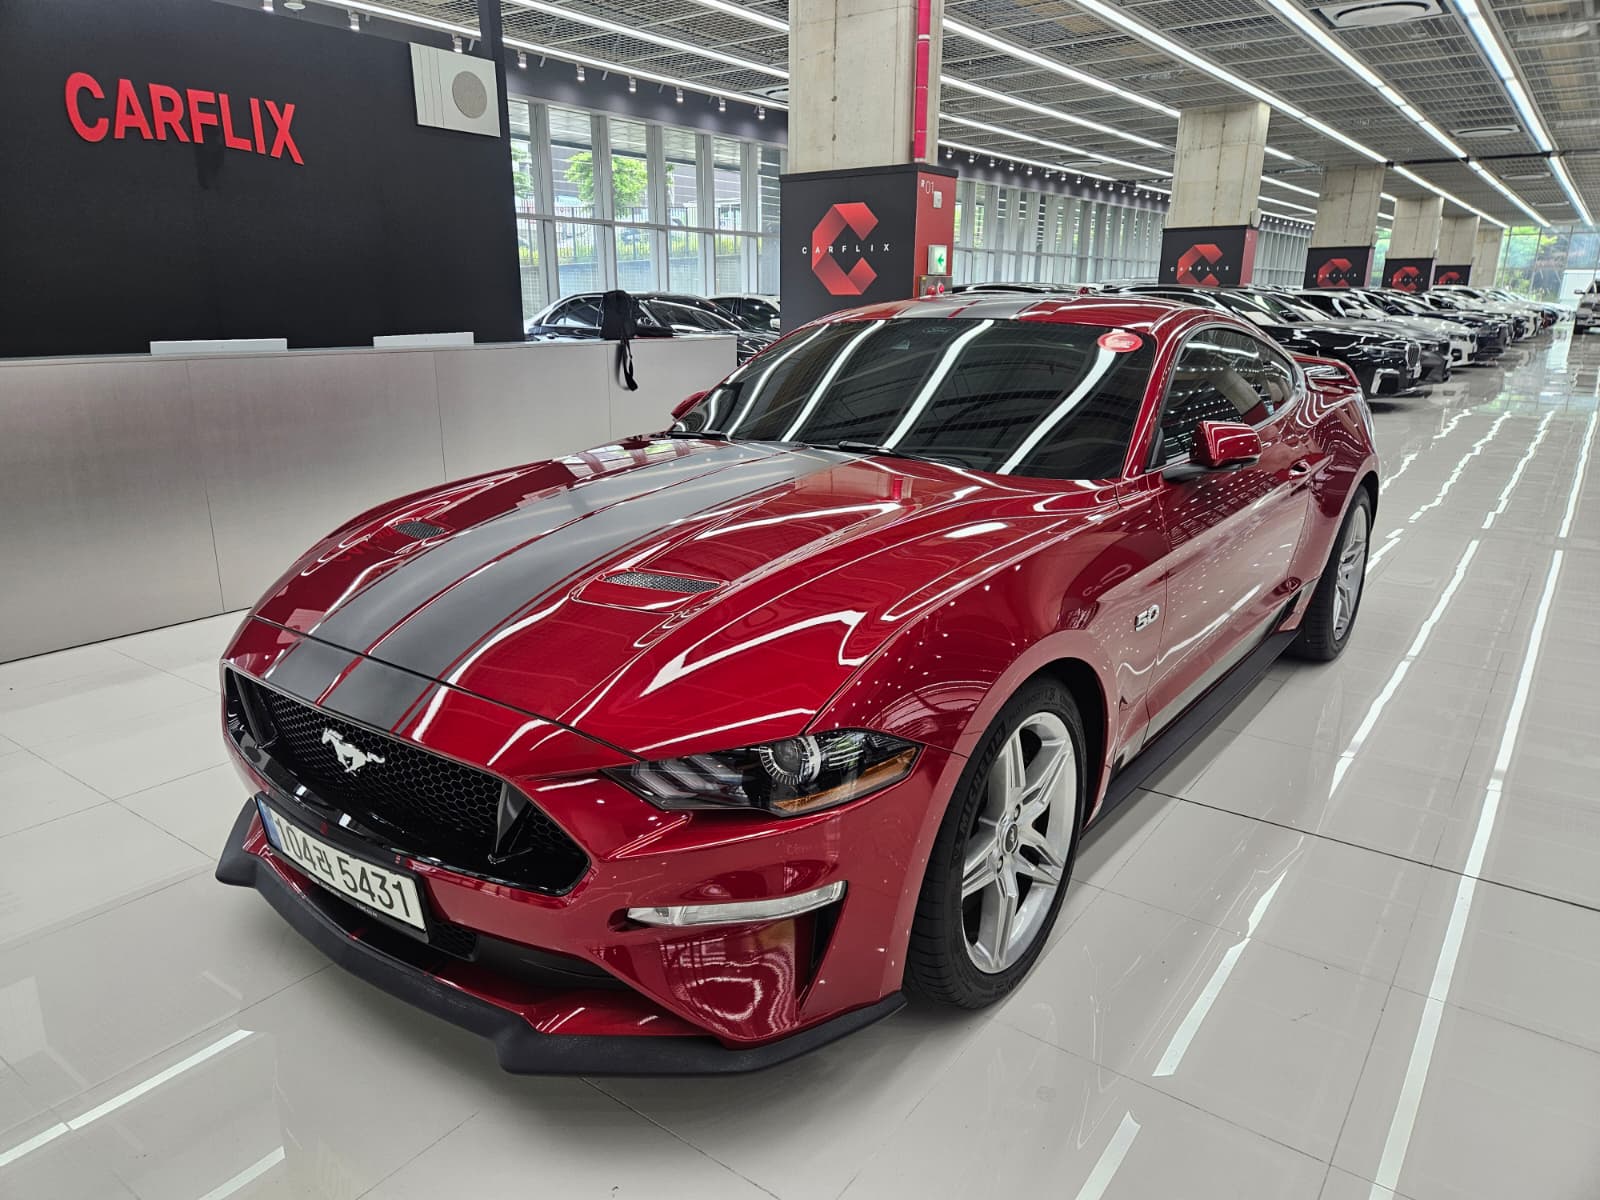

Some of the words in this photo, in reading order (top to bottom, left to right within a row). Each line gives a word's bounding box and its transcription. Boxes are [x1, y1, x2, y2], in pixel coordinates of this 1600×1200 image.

[65, 72, 304, 165] CARFLIX
[802, 243, 889, 254] CARFLIX
[960, 725, 1004, 834] MICHELIN
[337, 855, 410, 917] 5431
